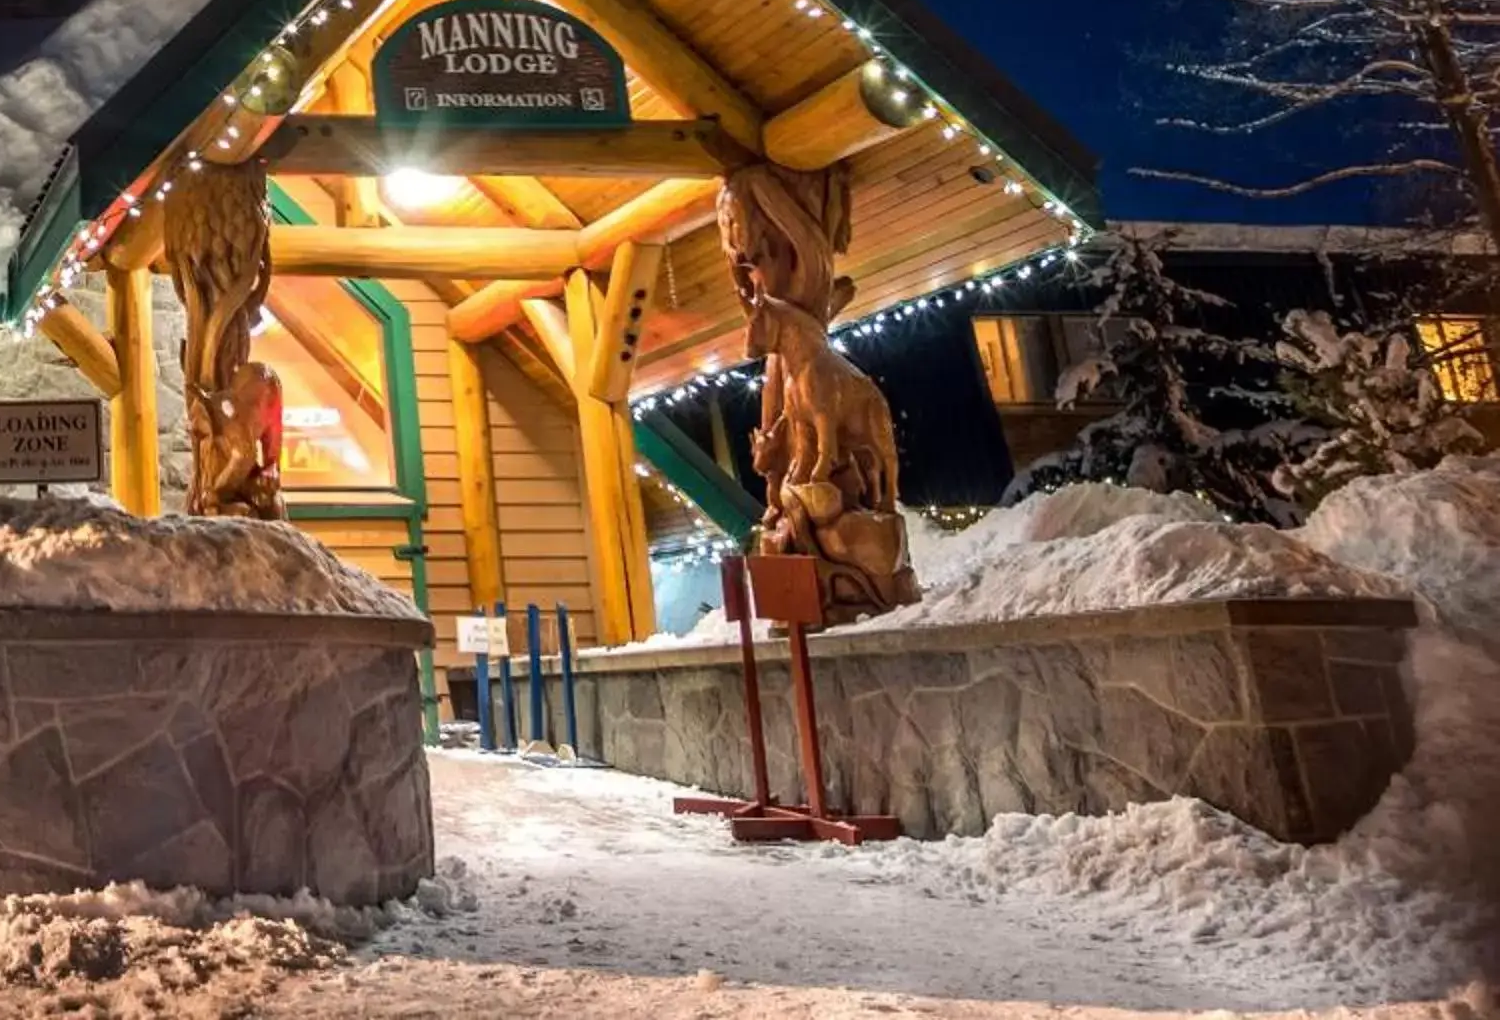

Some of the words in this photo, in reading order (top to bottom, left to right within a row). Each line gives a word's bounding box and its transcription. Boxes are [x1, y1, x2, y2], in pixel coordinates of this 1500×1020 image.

[417, 13, 579, 59] MANNING
[445, 53, 558, 75] LODGE
[436, 93, 573, 108] INFORMATION
[12, 436, 69, 453] ZONE
